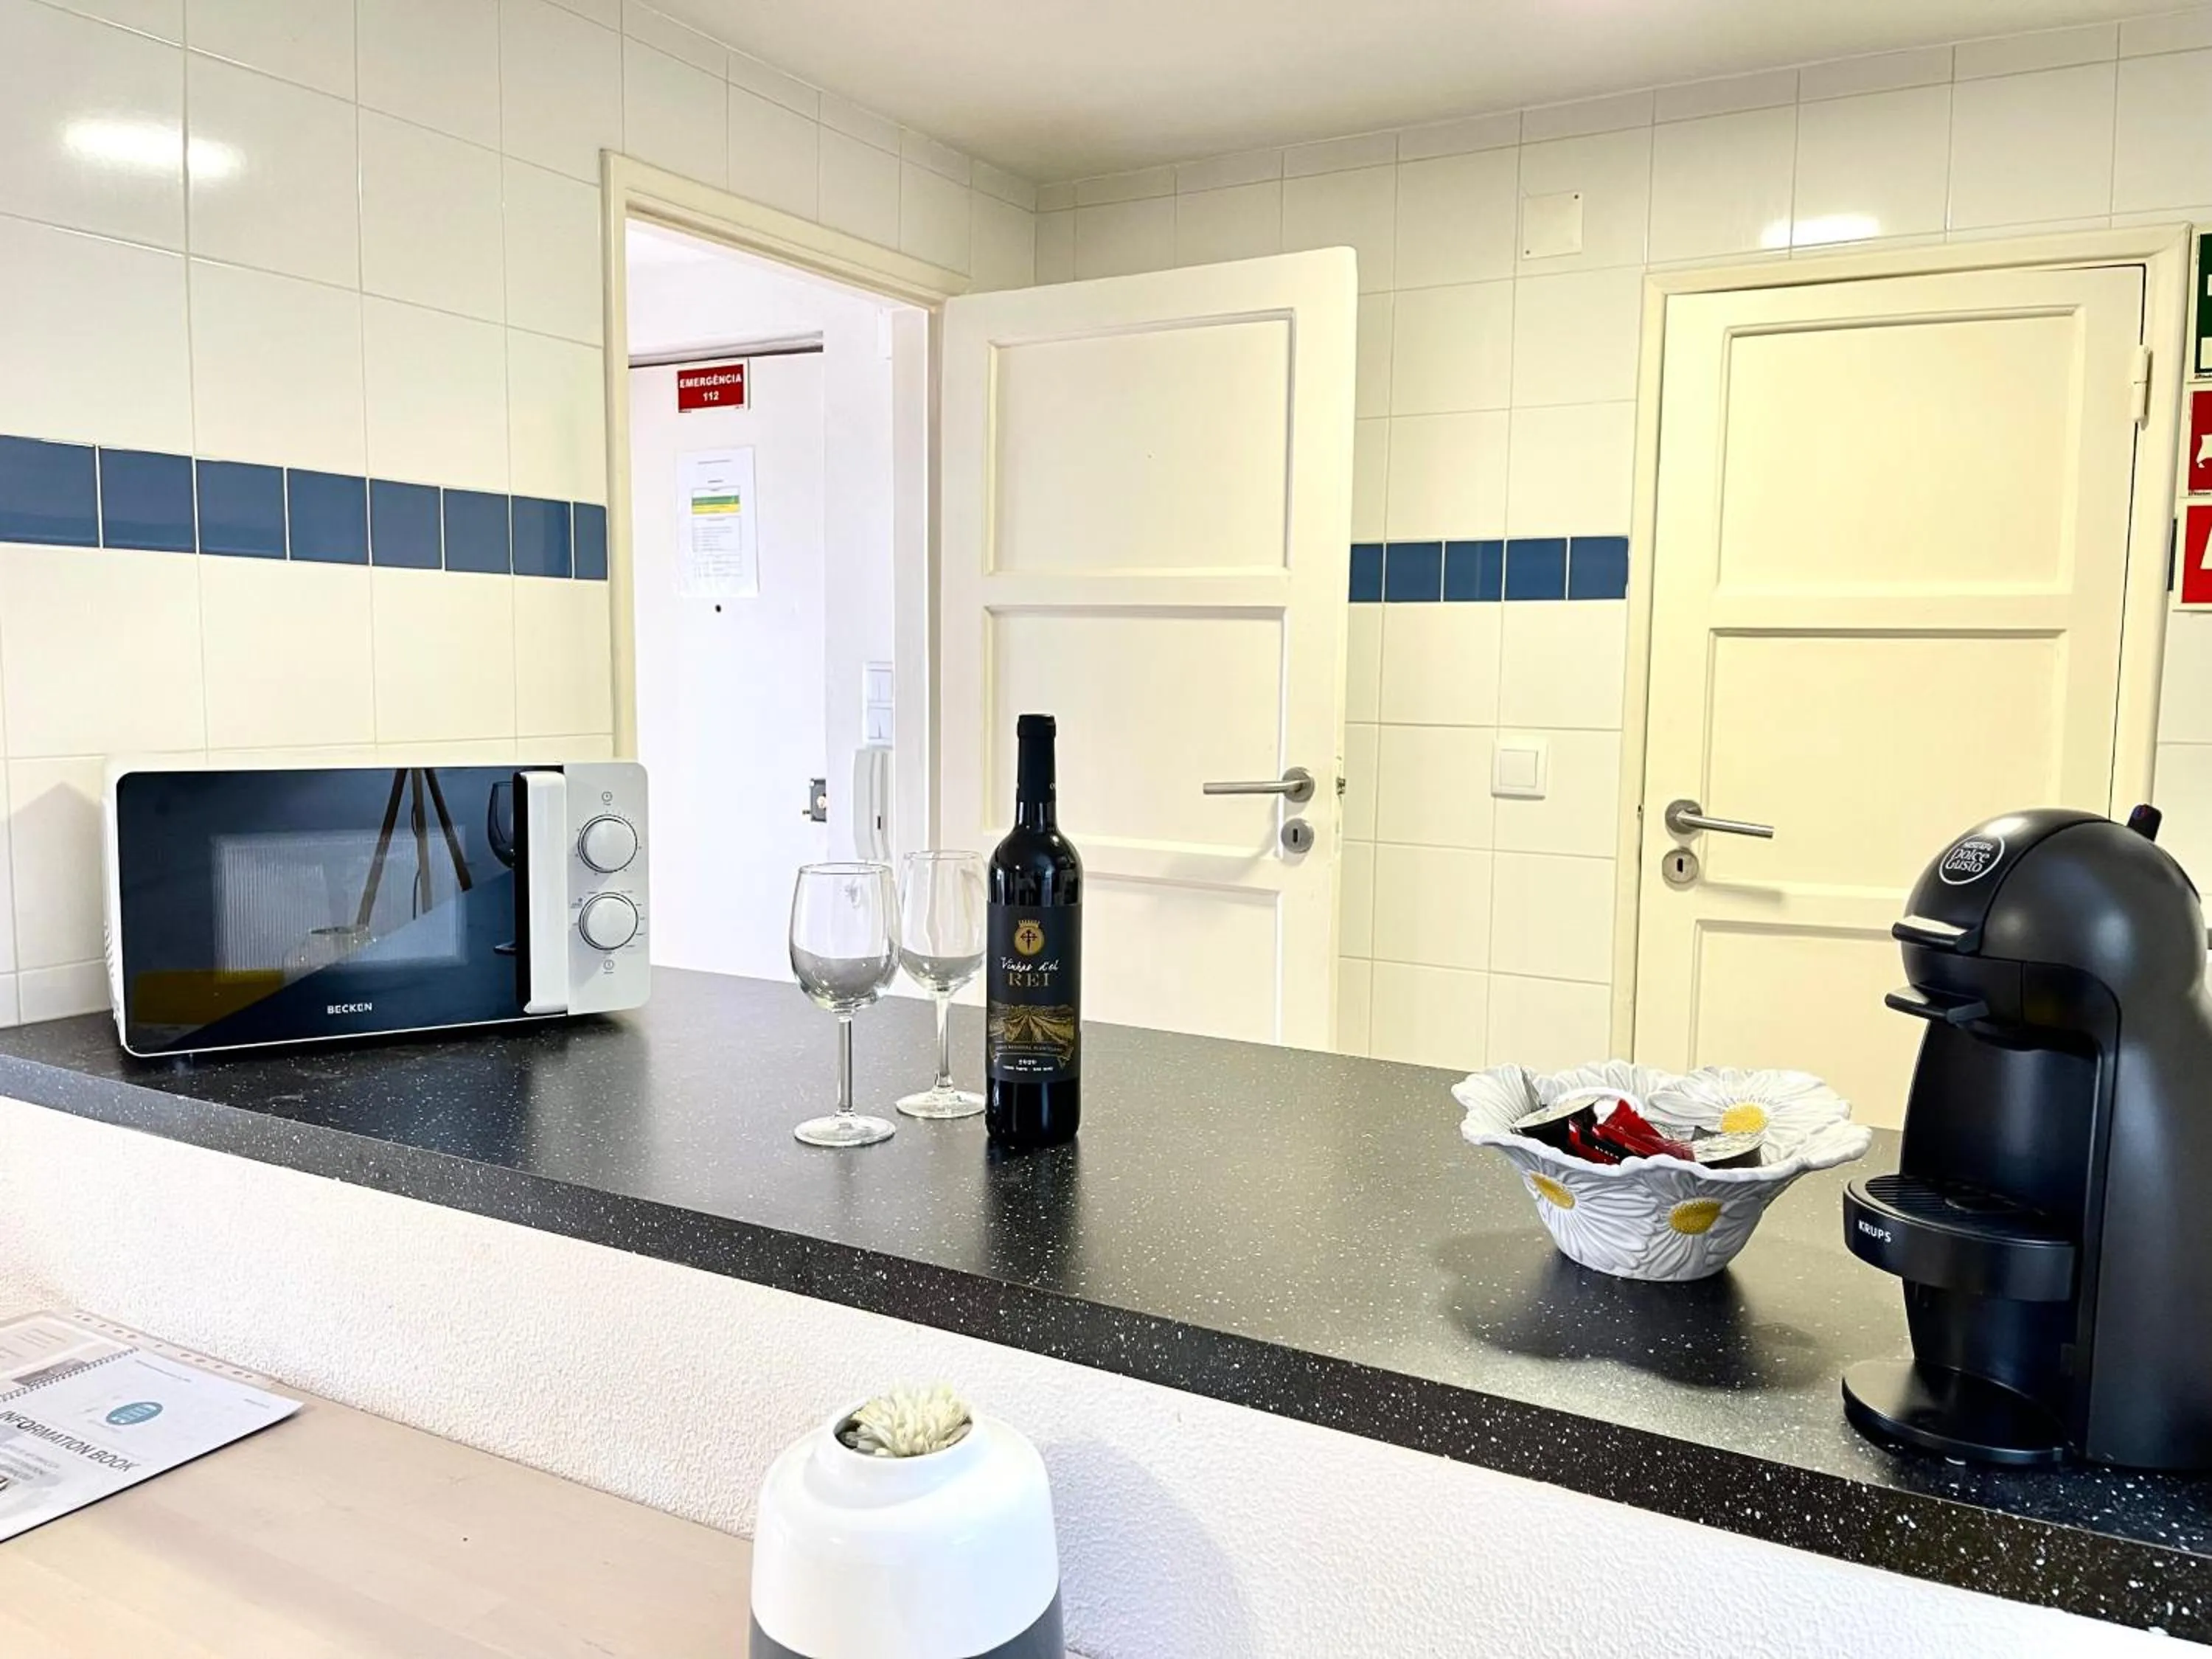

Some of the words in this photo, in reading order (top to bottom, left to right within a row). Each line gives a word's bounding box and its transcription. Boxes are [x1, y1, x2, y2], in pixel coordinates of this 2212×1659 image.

[679, 373, 742, 389] EMERGÊNCIA
[703, 391, 719, 402] 112
[1008, 973, 1049, 987] REI
[327, 1003, 372, 1015] BECKEN
[1858, 1219, 1891, 1242] KRUPS
[88, 1450, 141, 1472] BOOK
